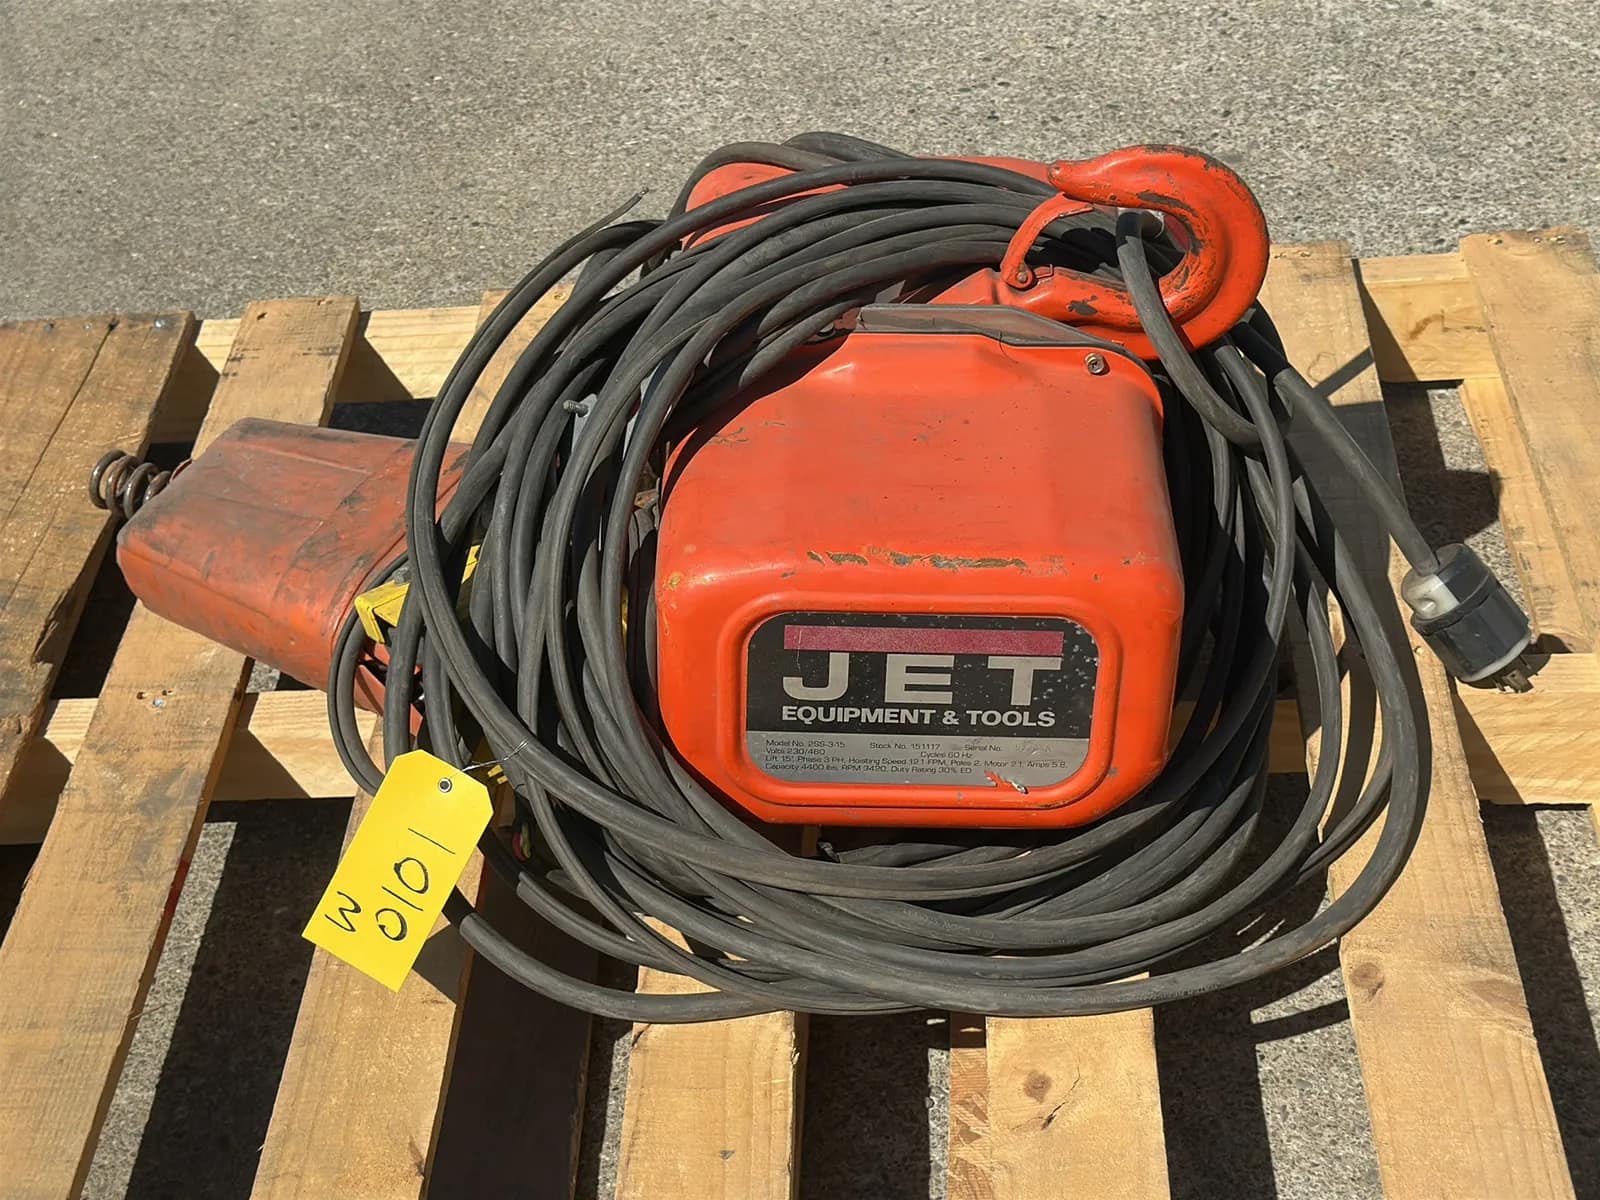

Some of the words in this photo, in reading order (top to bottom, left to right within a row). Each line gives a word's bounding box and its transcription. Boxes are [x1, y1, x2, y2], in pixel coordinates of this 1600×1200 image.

[783, 652, 1062, 706] JET
[782, 706, 936, 725] EQUIPMENT
[942, 709, 960, 725] &
[966, 710, 1056, 728] TOOLS
[920, 751, 946, 759] Cycles
[881, 757, 907, 766] Speed
[765, 763, 799, 771] Capacity
[890, 766, 910, 774] Duty
[911, 766, 937, 775] Rating
